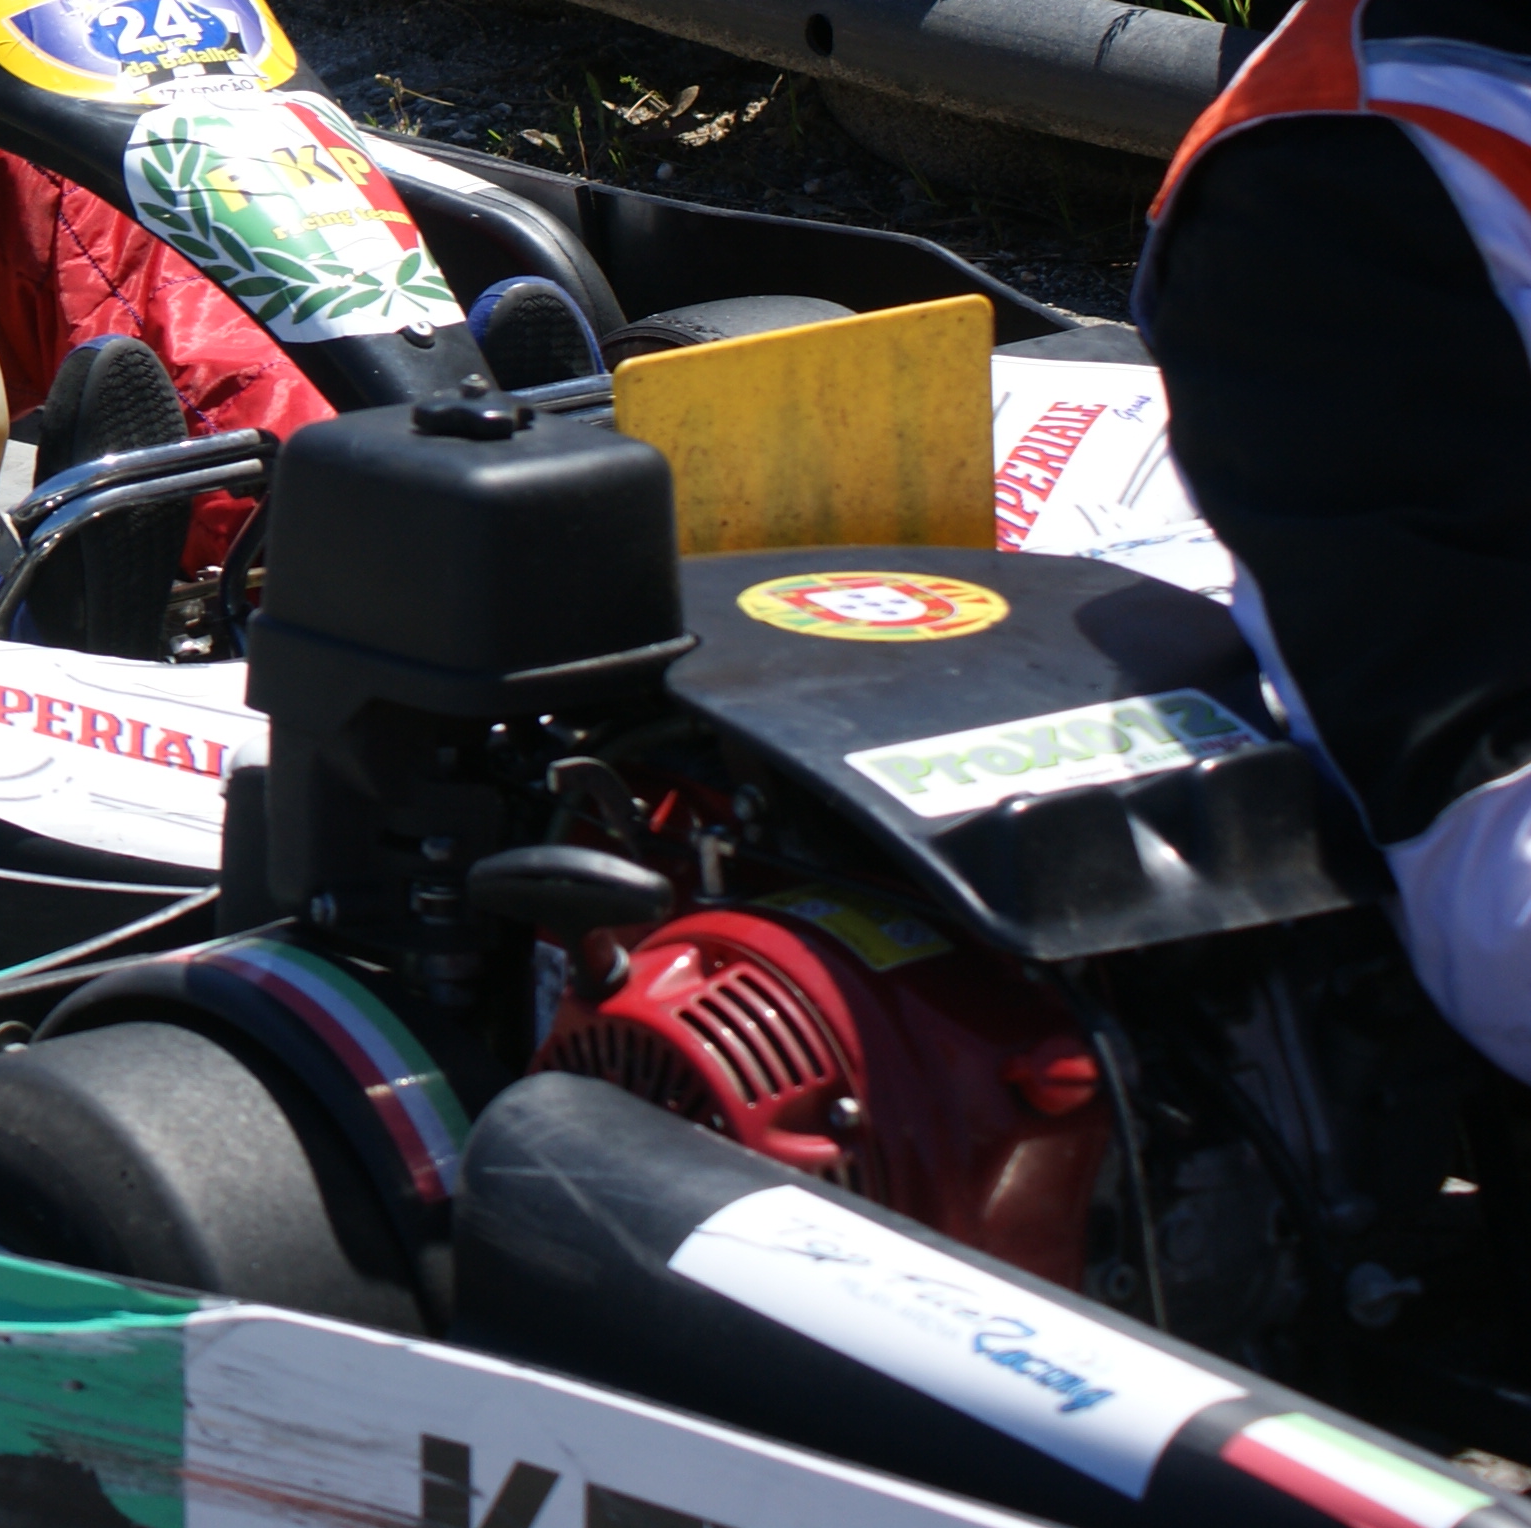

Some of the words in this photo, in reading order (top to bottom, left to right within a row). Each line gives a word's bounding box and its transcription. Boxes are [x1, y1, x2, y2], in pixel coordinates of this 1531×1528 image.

[126, 60, 156, 78] da
[157, 47, 241, 71] Batalha
[995, 401, 1108, 553] MPERIALE
[869, 695, 1239, 795] ProX012
